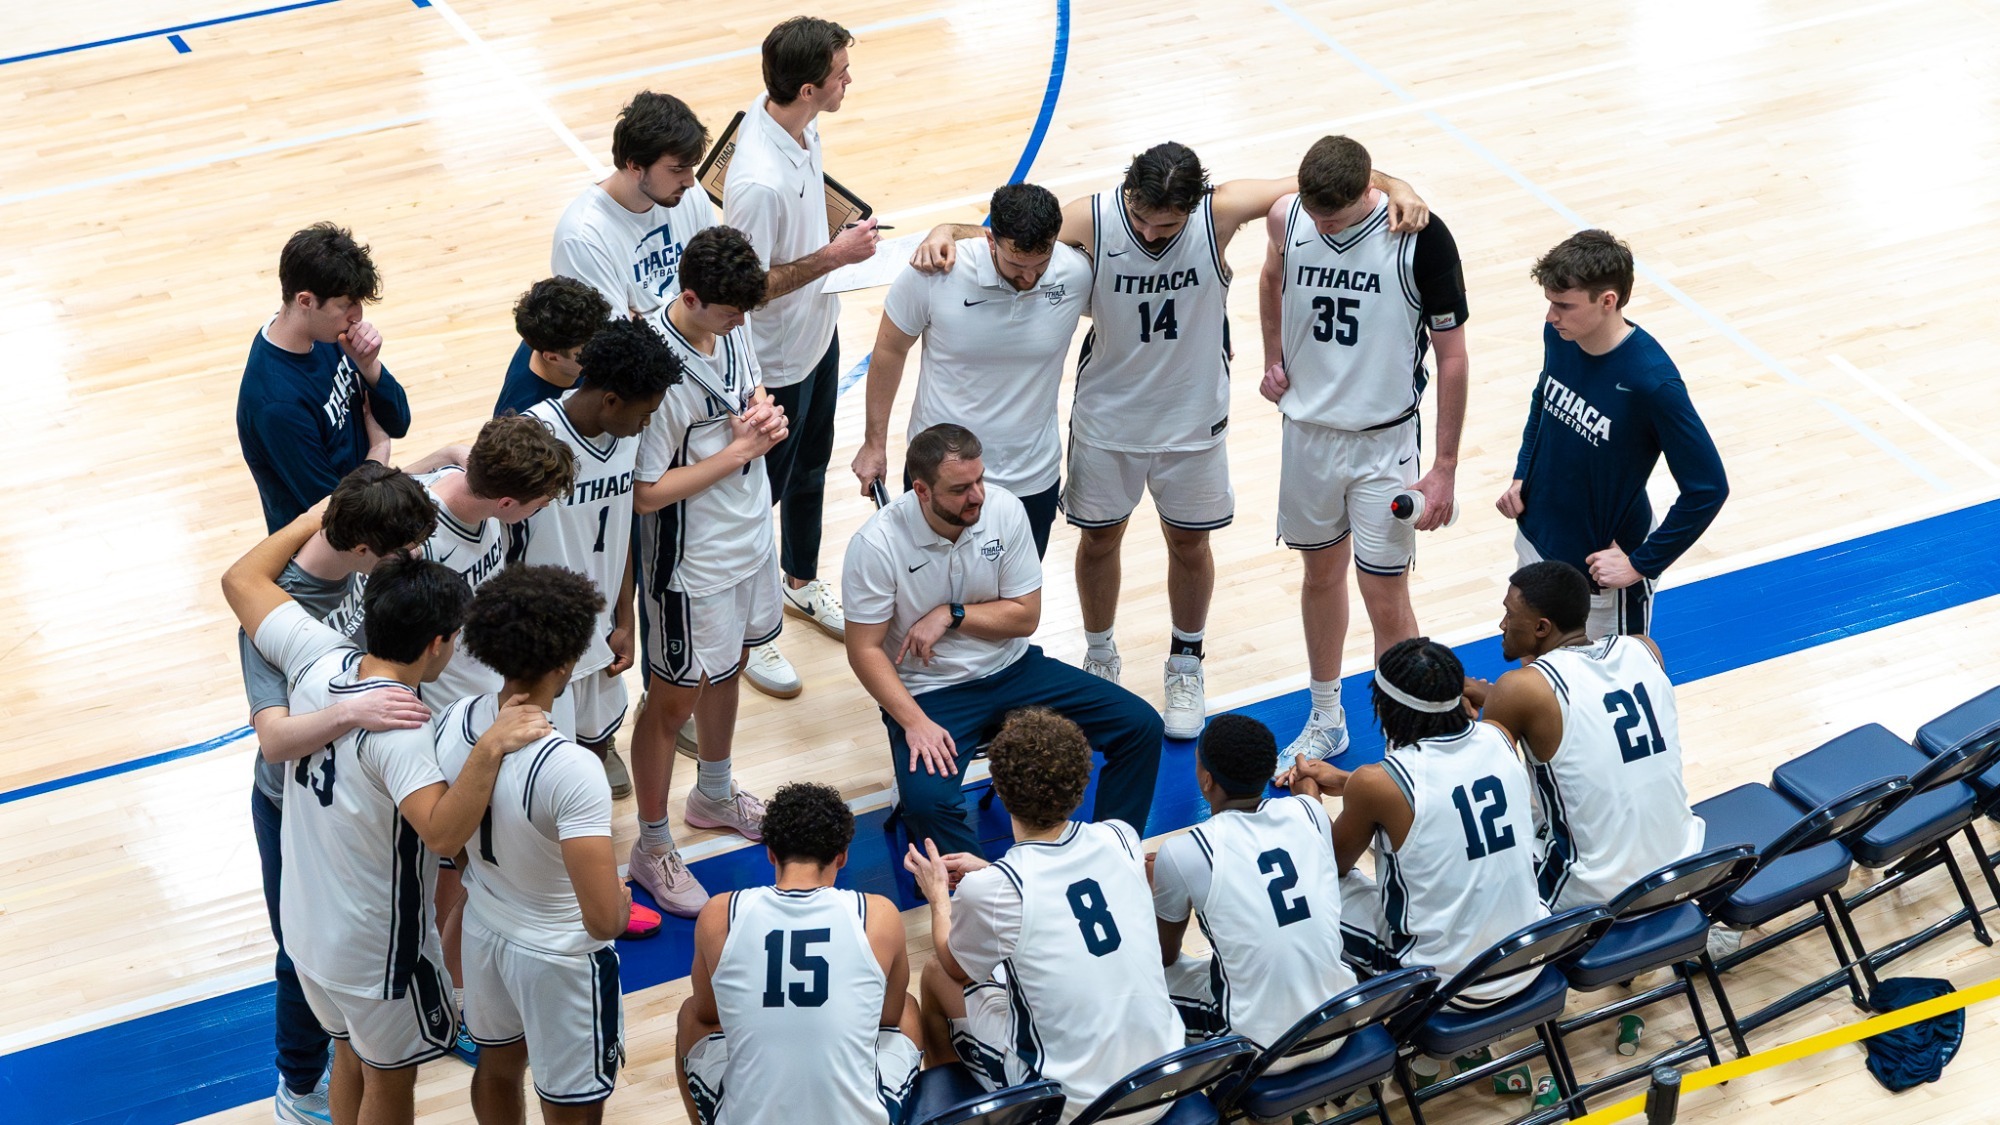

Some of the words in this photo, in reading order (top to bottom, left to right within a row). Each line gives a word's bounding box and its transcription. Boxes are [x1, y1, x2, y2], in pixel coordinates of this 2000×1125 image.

[1045, 290, 1066, 299] ITHACA
[1114, 267, 1200, 294] ITHACA
[1297, 265, 1381, 293] ITHACA
[1138, 298, 1178, 343] 14
[1312, 296, 1360, 346] 35
[1543, 375, 1612, 441] ITHACA
[1544, 400, 1599, 447] BASKETBALL
[593, 505, 610, 553] 1
[980, 544, 1004, 556] ITHACA
[1603, 682, 1667, 764] 21
[1452, 775, 1516, 861] 12
[1257, 847, 1312, 928] 2
[1065, 877, 1122, 958] 8
[763, 927, 831, 1008] 15
